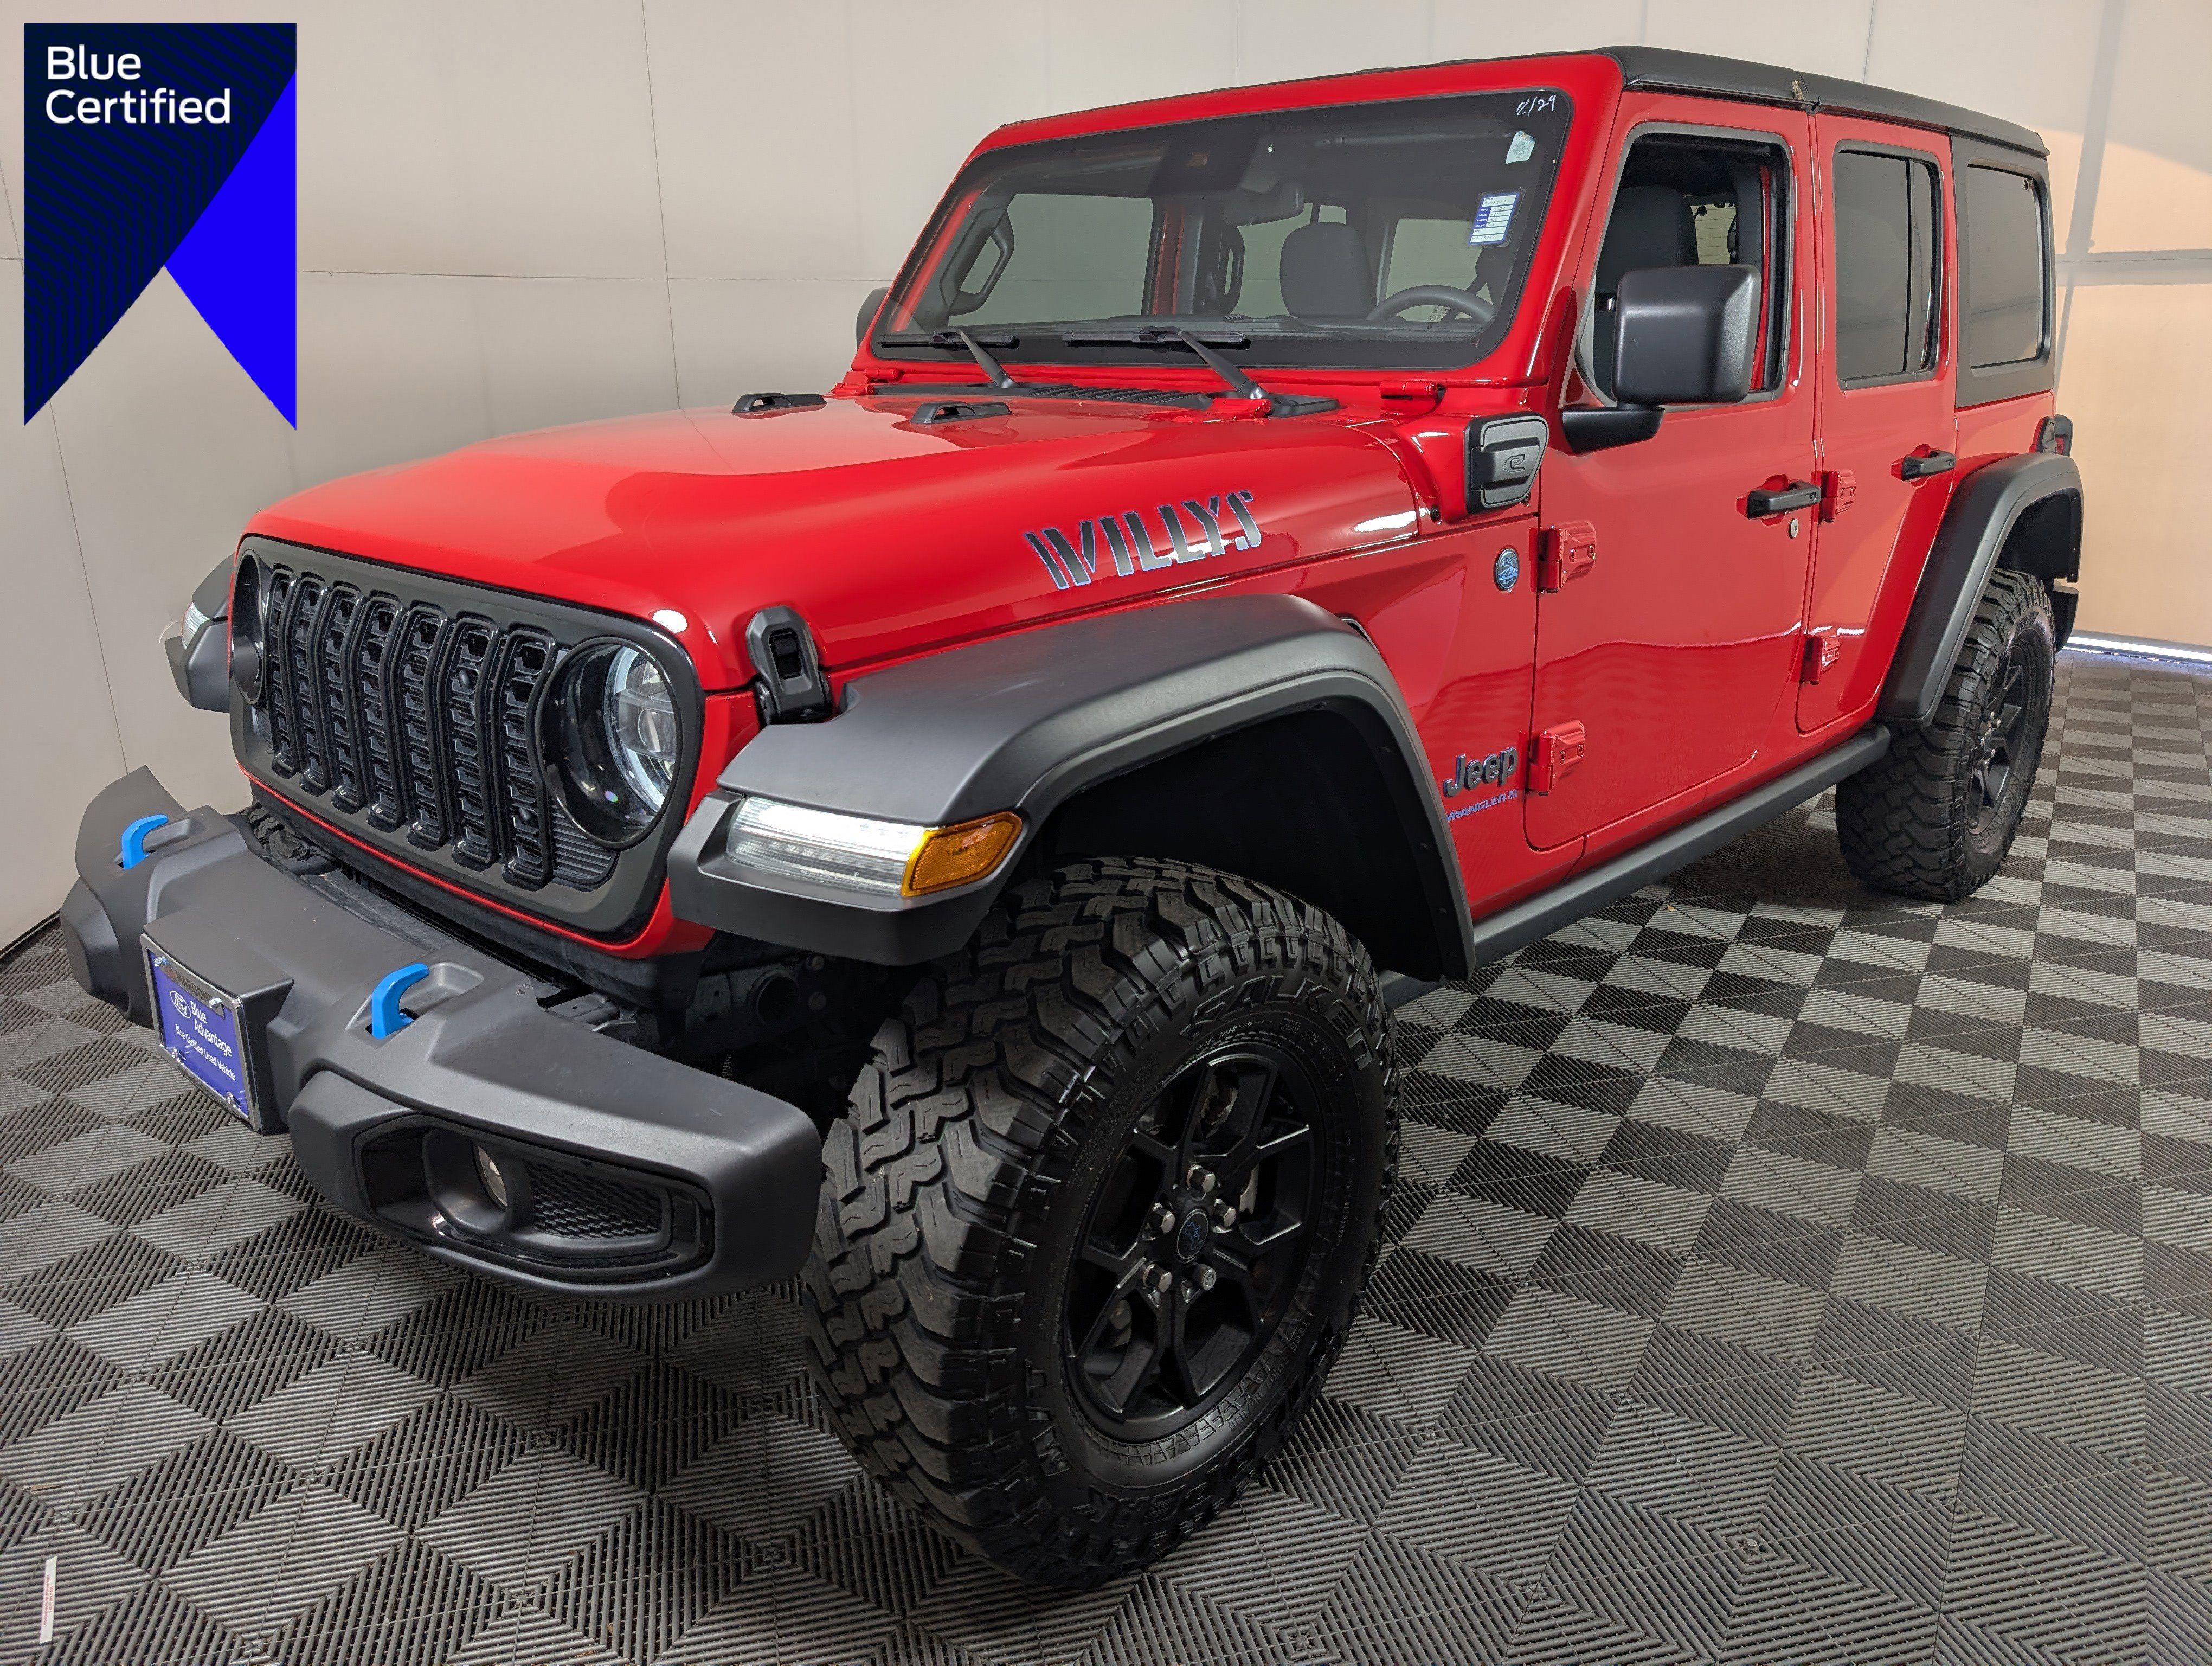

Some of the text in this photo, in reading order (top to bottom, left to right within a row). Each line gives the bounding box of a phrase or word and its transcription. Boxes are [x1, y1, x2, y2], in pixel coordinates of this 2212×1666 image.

[1024, 490, 1262, 589] WILLYS
[1443, 746, 1517, 798] Jeep
[172, 992, 190, 1017] Ford
[190, 1001, 207, 1024] Blue
[1180, 975, 1375, 1071] FALKEN
[175, 1024, 236, 1081] Blue Certified Used Vehicle
[194, 1019, 232, 1058] Advantage
